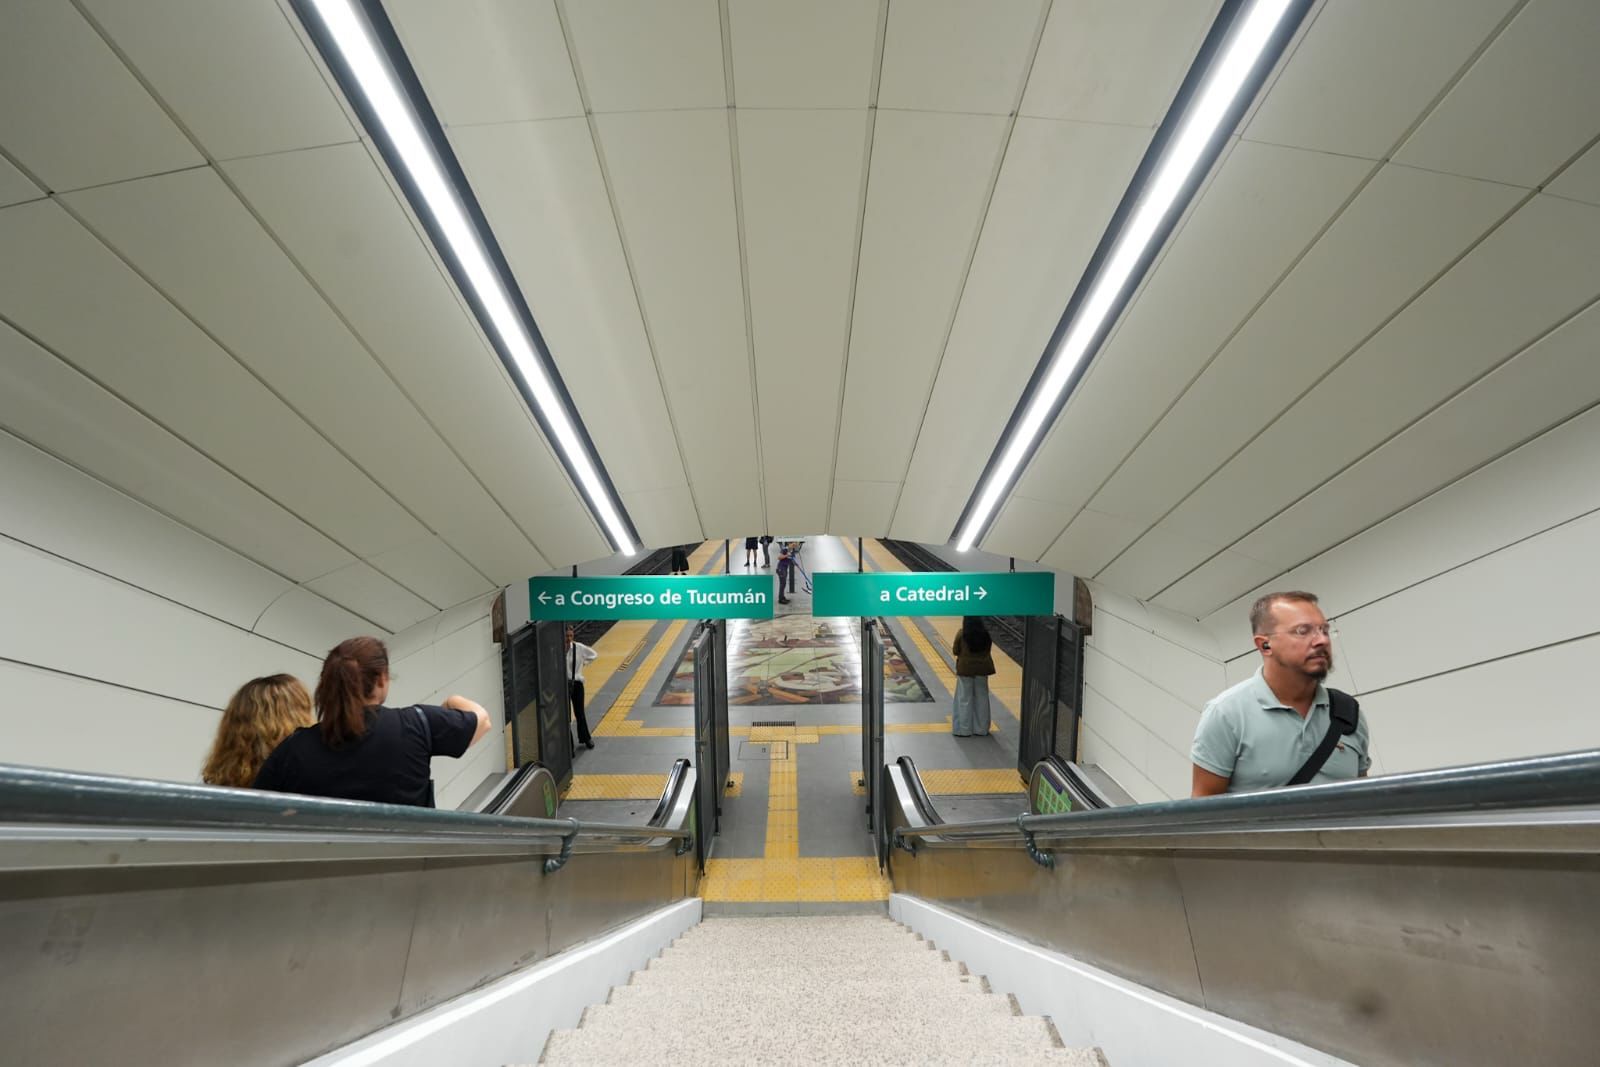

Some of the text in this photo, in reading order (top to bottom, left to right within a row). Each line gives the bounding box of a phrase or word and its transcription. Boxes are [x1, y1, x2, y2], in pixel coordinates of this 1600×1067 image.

[555, 588, 766, 609] a Congreso de Tucumán
[879, 585, 970, 602] a Catedral
